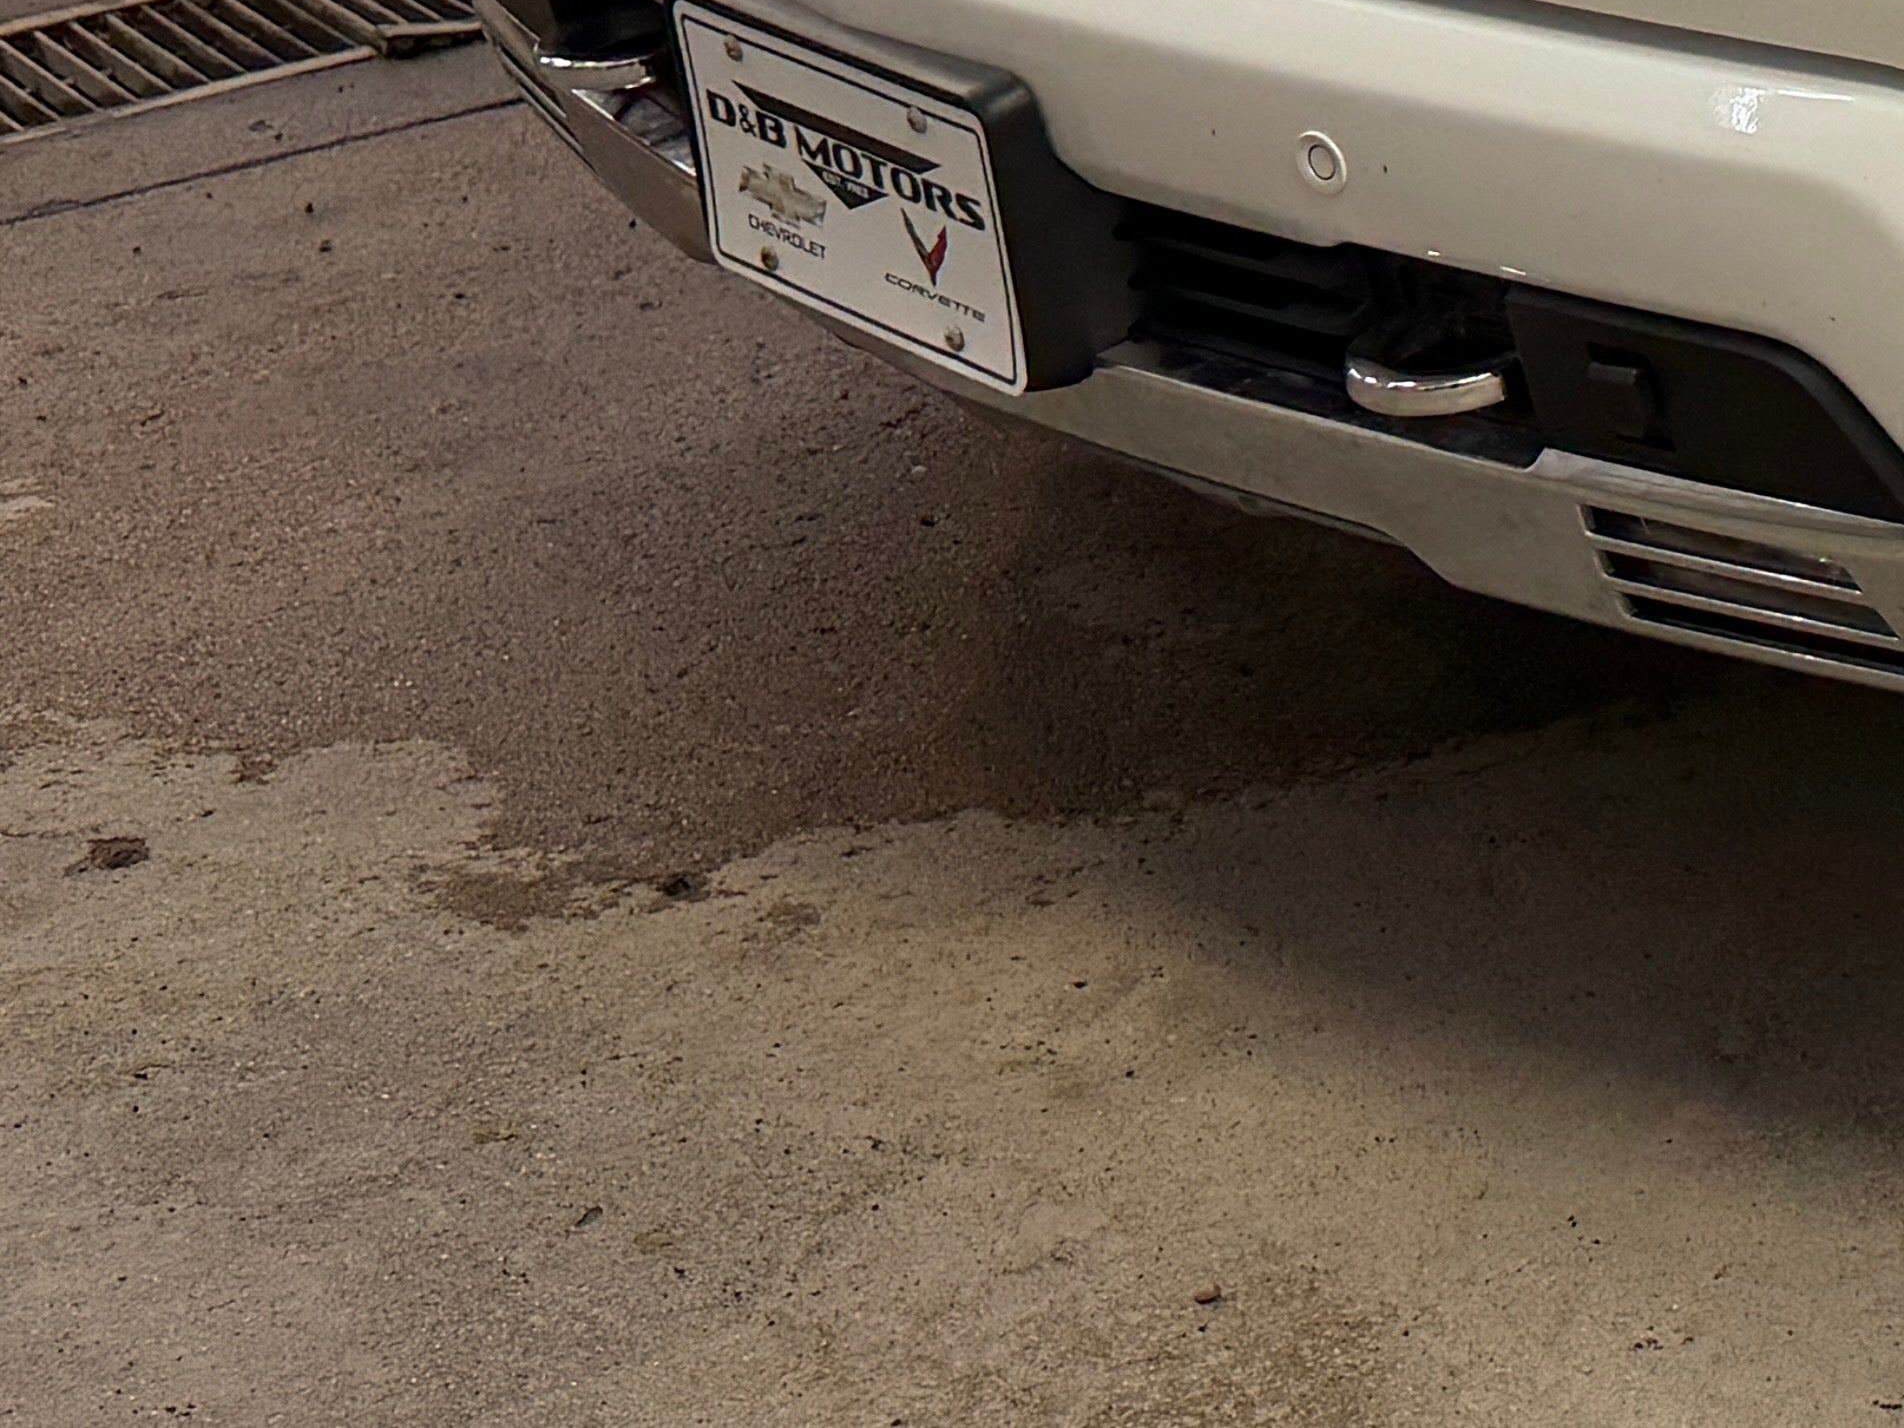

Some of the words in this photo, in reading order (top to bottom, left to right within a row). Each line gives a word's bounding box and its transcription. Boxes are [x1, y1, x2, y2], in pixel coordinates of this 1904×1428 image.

[705, 88, 789, 149] D&B
[792, 124, 987, 233] MOTORS
[747, 213, 828, 262] CHEVROLET
[883, 271, 987, 324] CORVETTE
